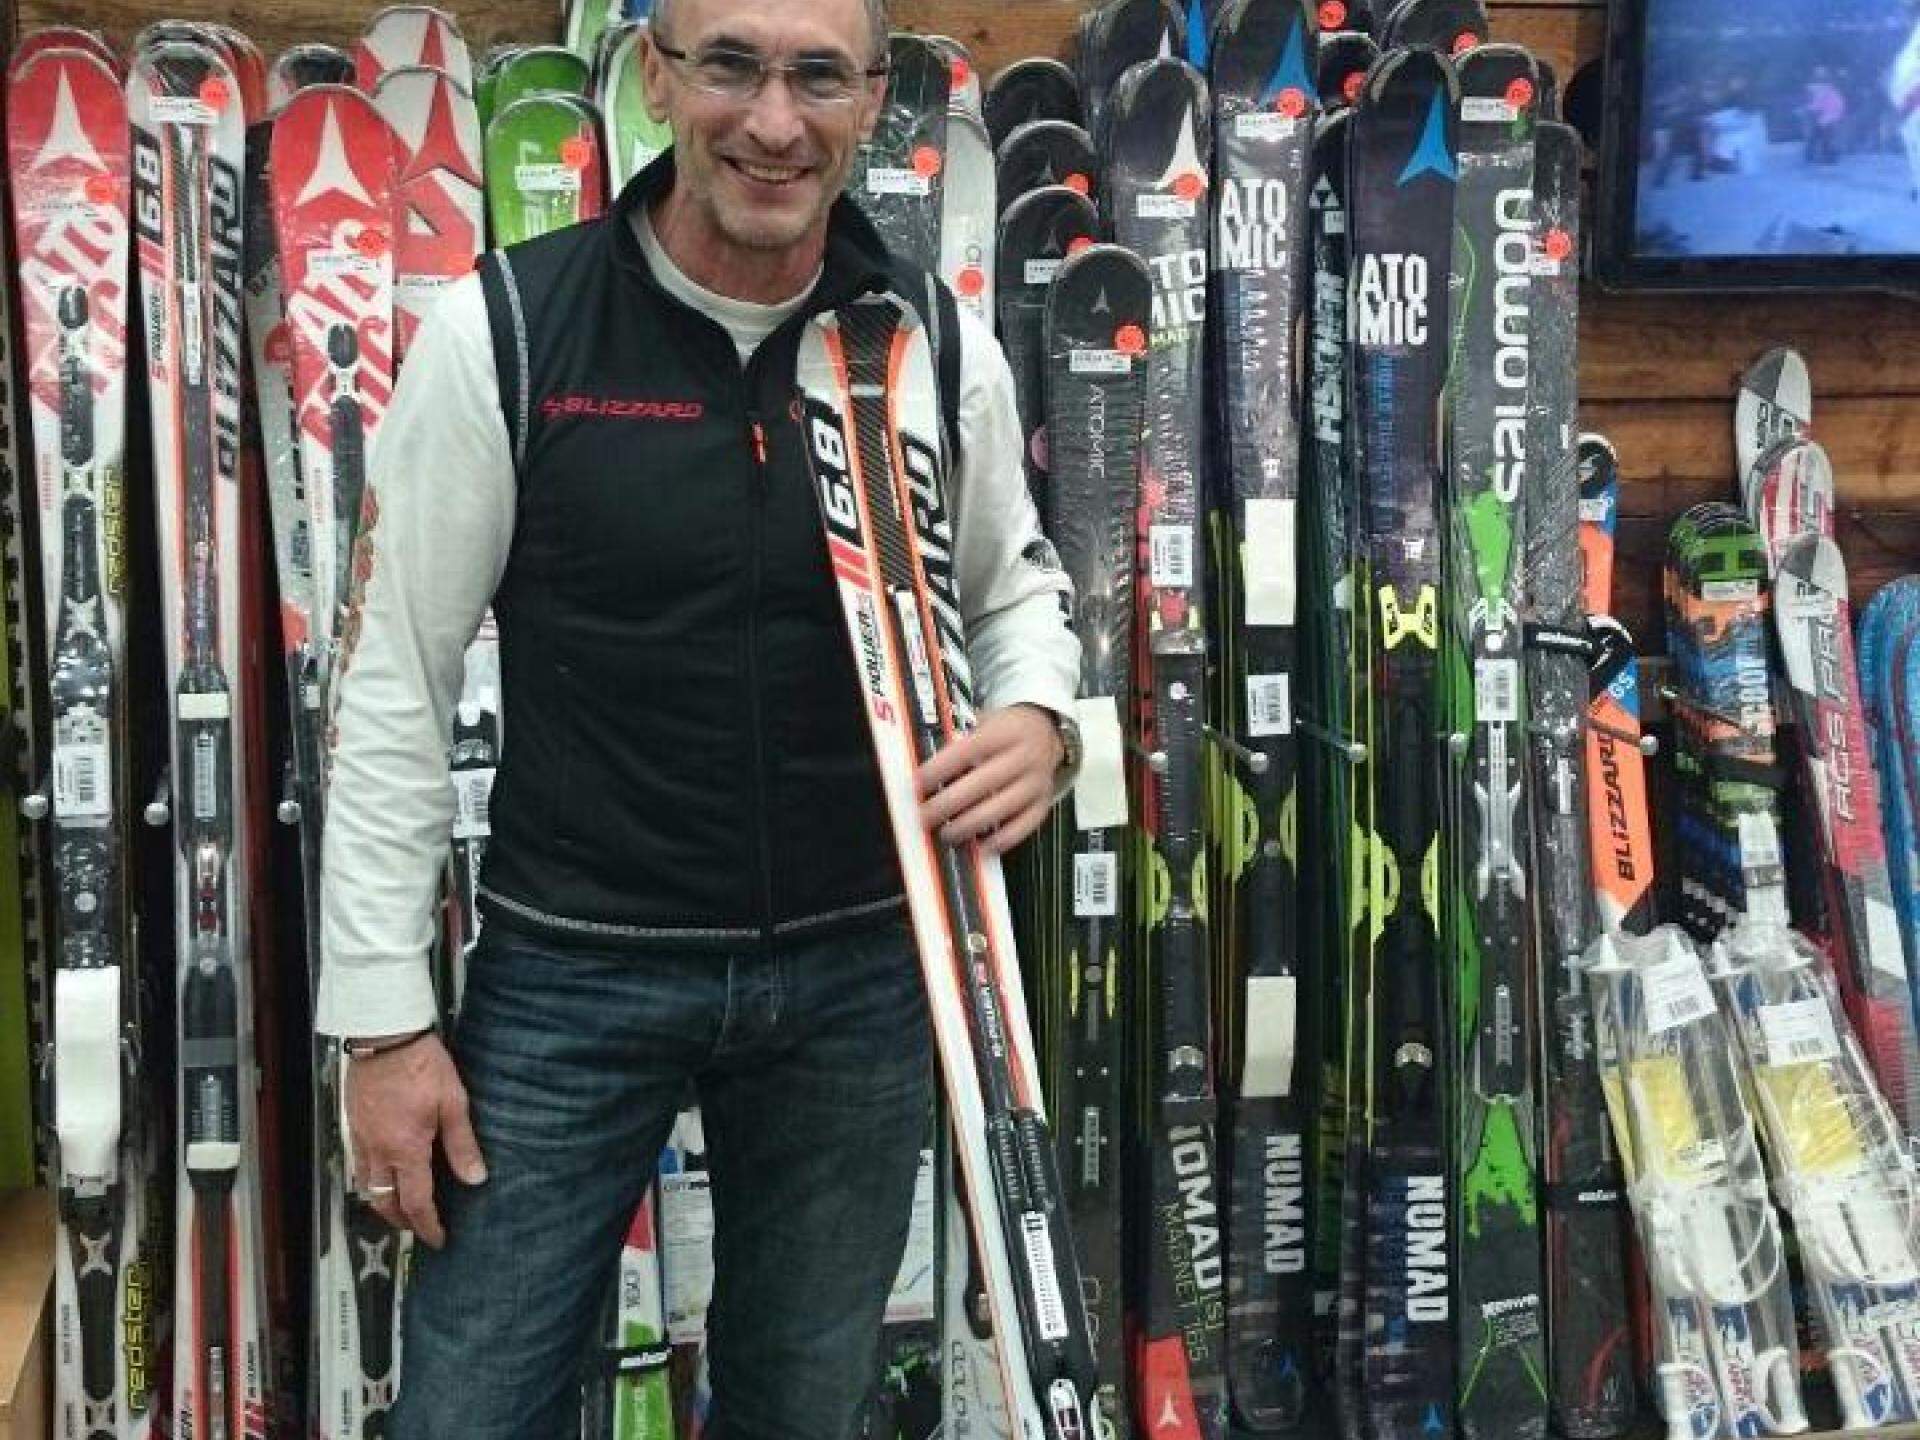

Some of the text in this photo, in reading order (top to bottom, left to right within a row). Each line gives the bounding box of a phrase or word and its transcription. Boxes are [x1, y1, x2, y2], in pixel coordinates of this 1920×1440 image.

[135, 142, 162, 236] 6.8
[1150, 249, 1206, 290] TO
[812, 417, 857, 531] 6.8
[1263, 1133, 1305, 1274] NOMAD
[1405, 1175, 1449, 1322] NOMAD
